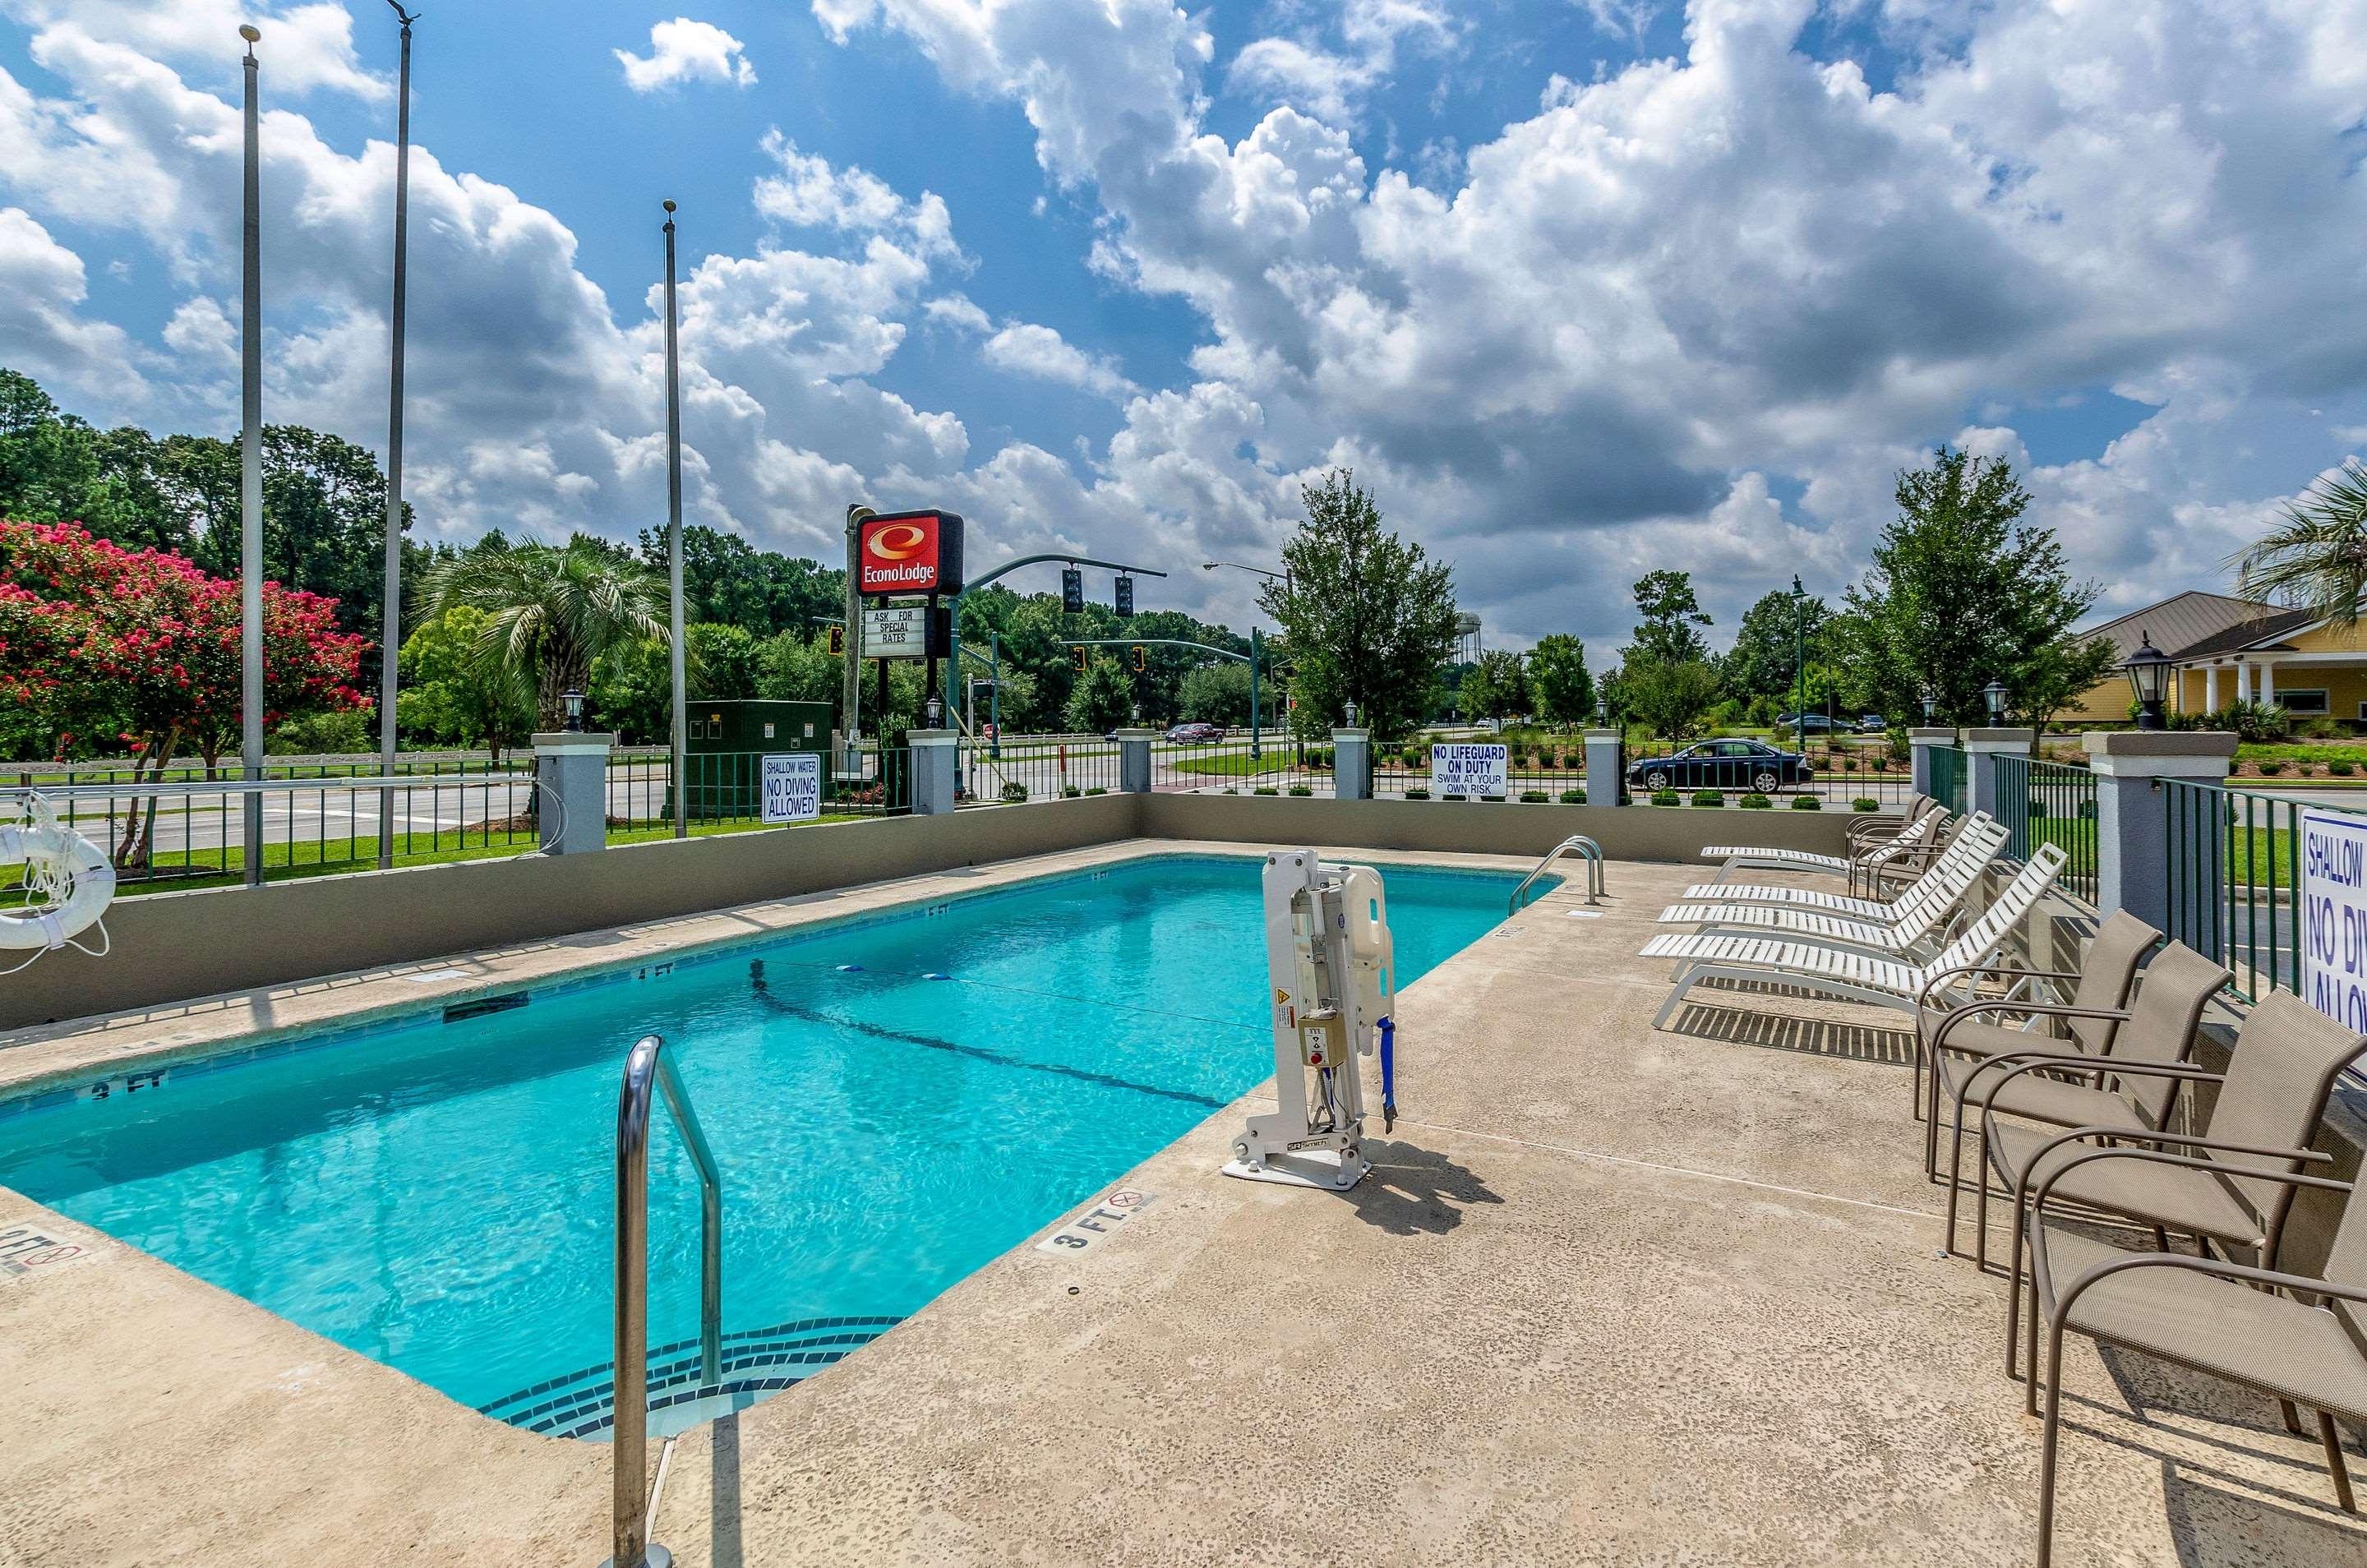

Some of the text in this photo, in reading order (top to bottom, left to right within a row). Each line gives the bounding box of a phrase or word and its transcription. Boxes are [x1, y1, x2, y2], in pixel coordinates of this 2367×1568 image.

[865, 562, 934, 583] EconoLodge
[874, 611, 913, 622] ASK FOR
[880, 622, 908, 632] SPECIAL
[882, 634, 906, 643] RATES
[1433, 746, 1505, 759] NO LIFEGUARD
[767, 761, 816, 774] SHALLOW WATER
[1448, 760, 1492, 773] ON DUTY
[1437, 774, 1502, 784] SWIM AT YOUR
[767, 777, 816, 796] NO DIVING
[1447, 784, 1492, 794] OWN RISK
[768, 797, 814, 817] ALLOWED
[2309, 832, 2363, 888] SHALLOW
[2309, 894, 2336, 966] NO
[1054, 1234, 1088, 1249] 3
